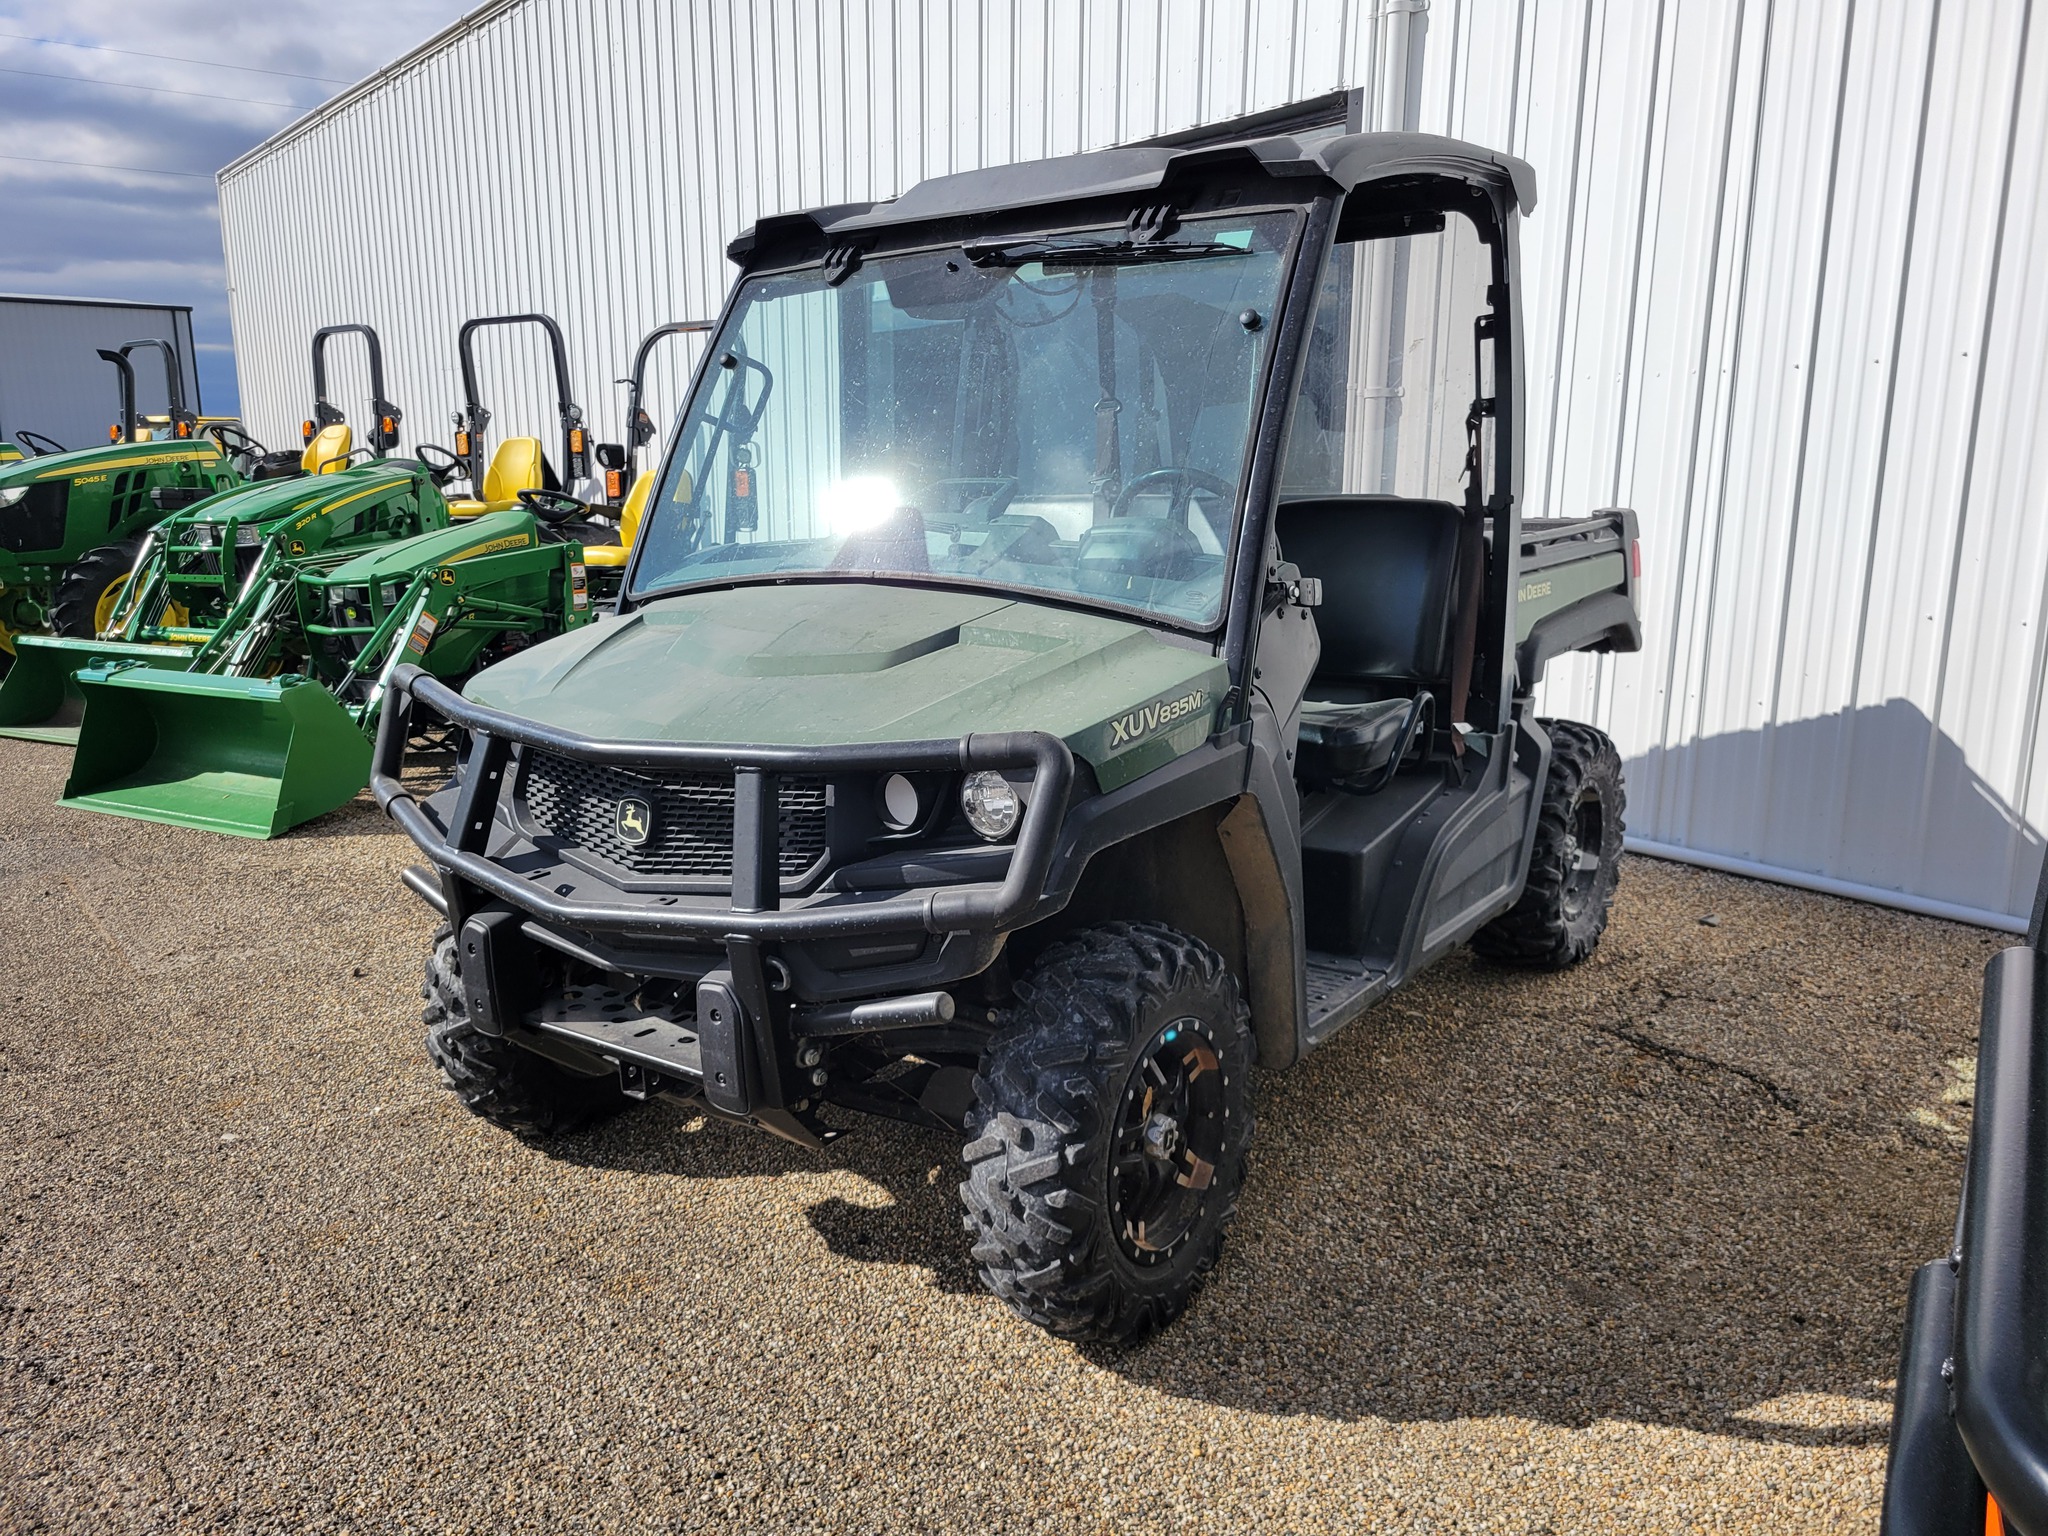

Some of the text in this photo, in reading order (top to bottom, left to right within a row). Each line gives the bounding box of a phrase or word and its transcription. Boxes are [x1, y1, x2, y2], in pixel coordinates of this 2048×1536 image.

[165, 455, 189, 463] DEERE
[74, 476, 100, 487] 5045
[295, 512, 317, 530] 320 R
[485, 538, 526, 553] JOHN DEERE
[1526, 581, 1551, 600] DEERE
[170, 633, 188, 641] JOHN
[1111, 689, 1203, 747] XUV835M
